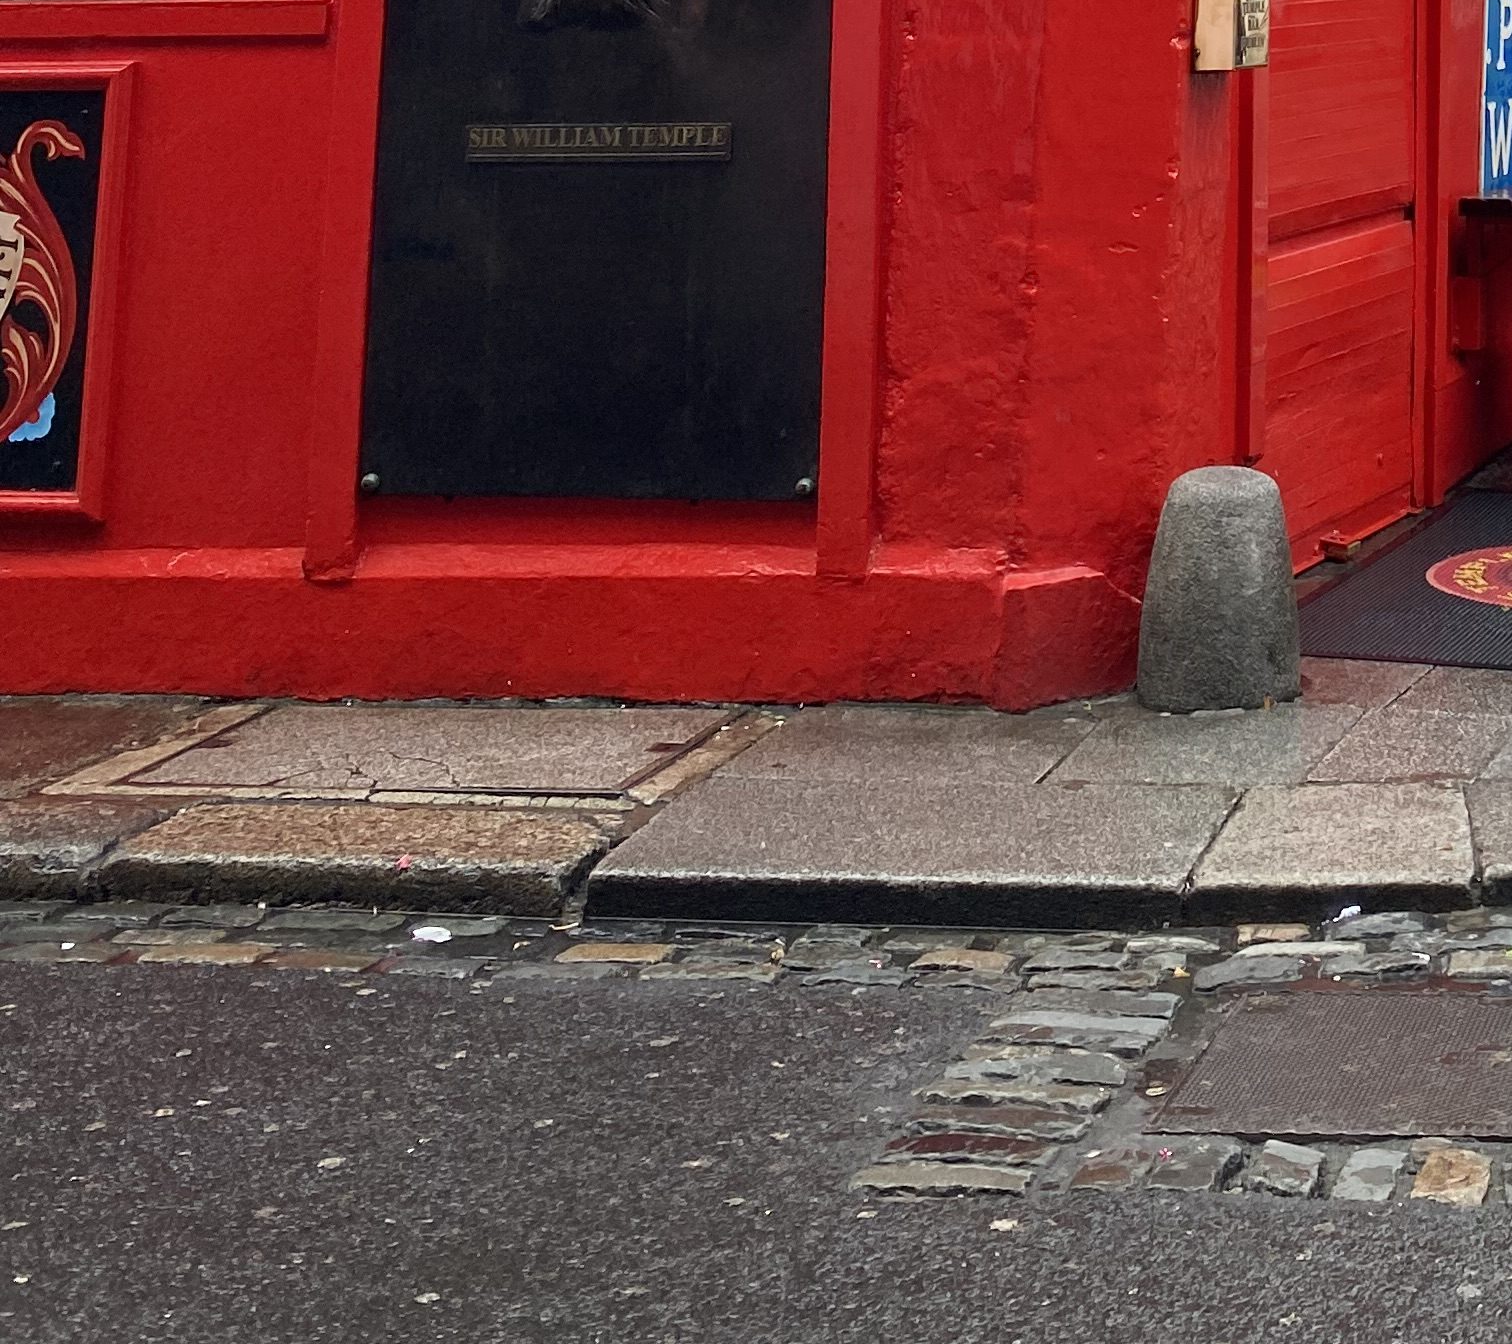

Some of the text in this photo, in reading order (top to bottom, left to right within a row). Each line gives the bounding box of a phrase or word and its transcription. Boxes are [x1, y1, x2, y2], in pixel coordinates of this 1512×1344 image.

[468, 125, 727, 150] SIR WILLIAM TEMPLE
